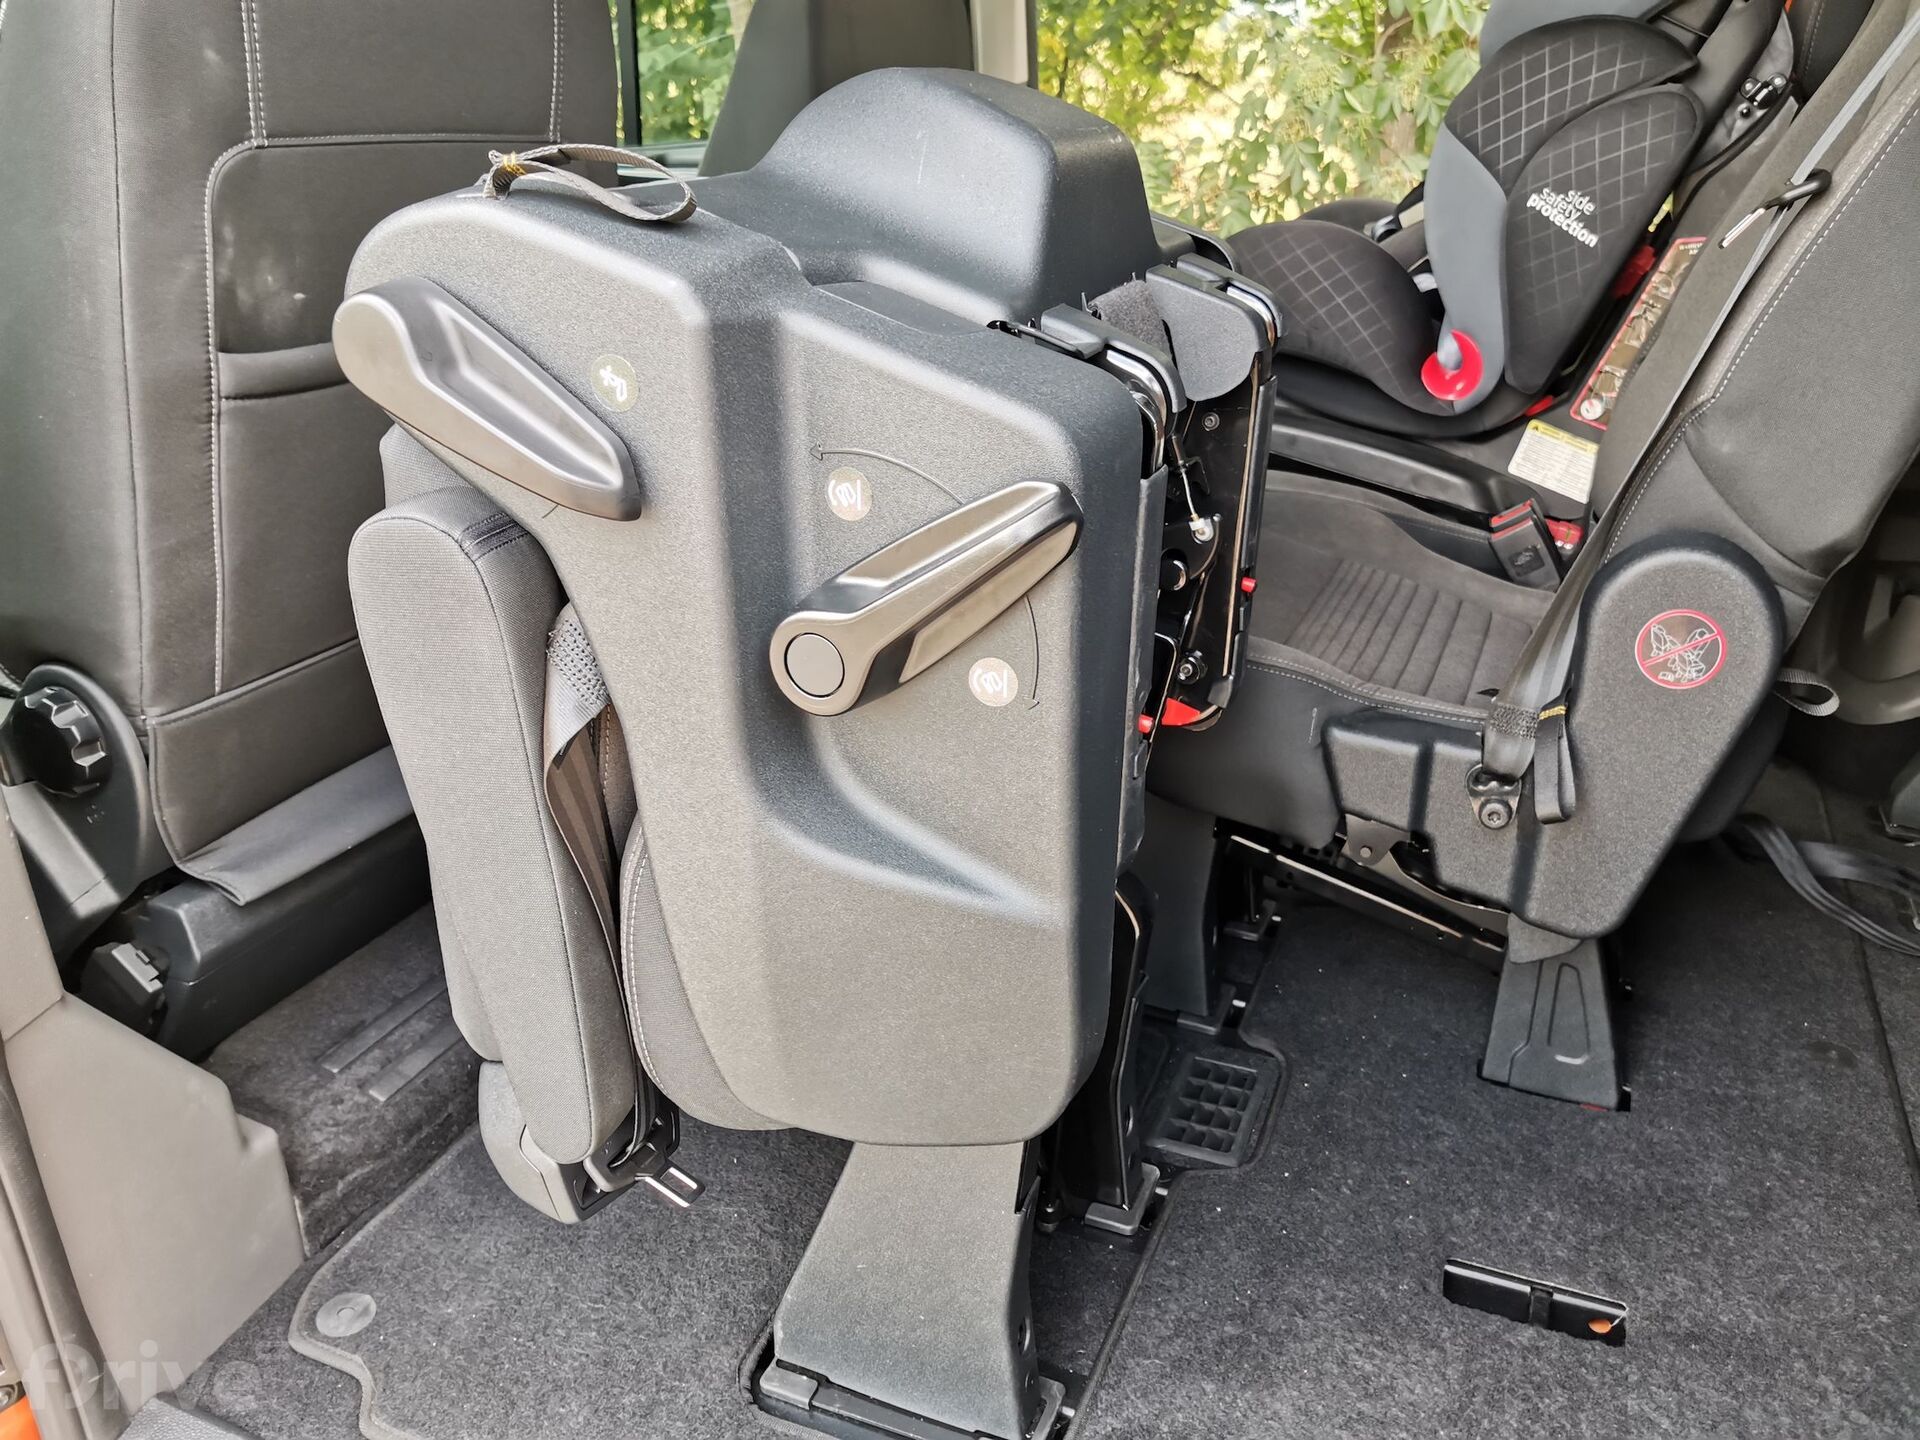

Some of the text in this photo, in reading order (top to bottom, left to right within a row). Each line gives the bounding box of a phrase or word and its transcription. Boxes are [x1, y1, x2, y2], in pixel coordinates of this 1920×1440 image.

[1540, 188, 1581, 221] safety
[1565, 190, 1595, 215] side
[1526, 193, 1599, 248] protection
